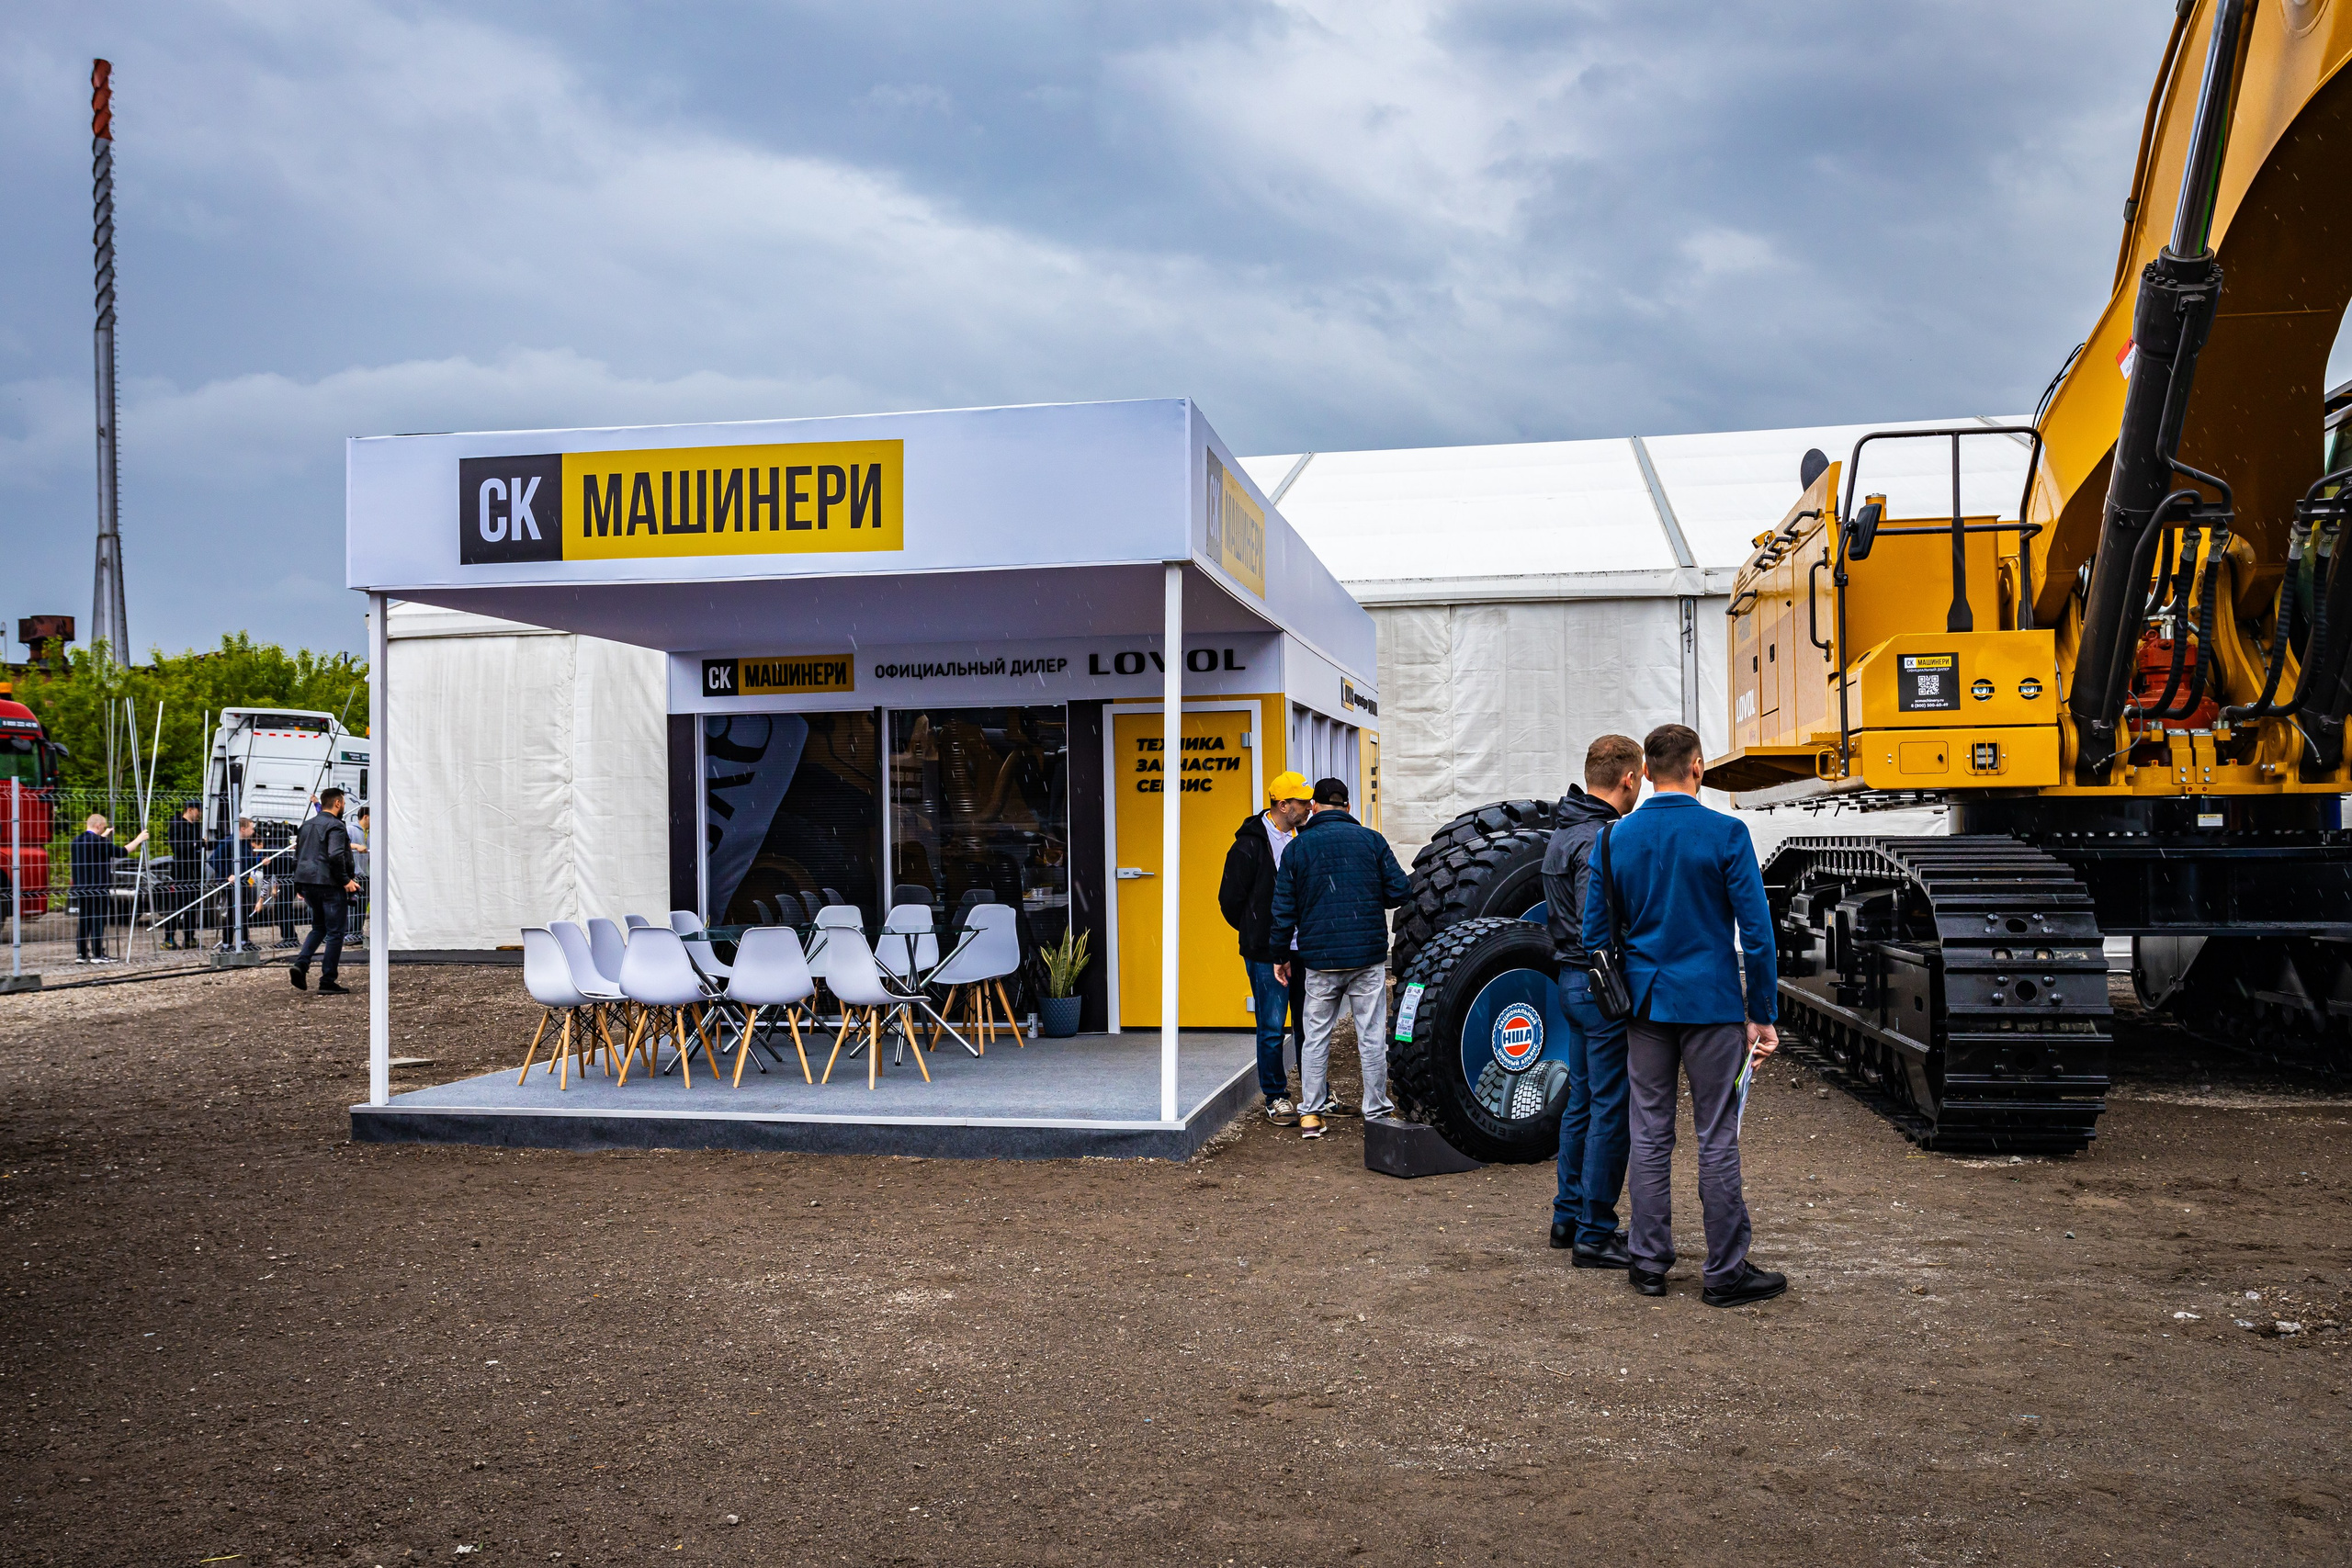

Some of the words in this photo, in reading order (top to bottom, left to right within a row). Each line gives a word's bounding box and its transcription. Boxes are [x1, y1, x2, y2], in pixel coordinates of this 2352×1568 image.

[479, 476, 542, 543] СК
[583, 463, 882, 538] МАШИНЕРИ
[1209, 473, 1220, 543] СК
[1225, 489, 1263, 581] МАШИНЕРИ
[708, 665, 732, 690] СК
[744, 661, 847, 688] МАШИНЕРИ
[875, 658, 1006, 680] ОФИЦИАЛЬНЫЙ
[1010, 658, 1068, 677] ДИЛЕР
[1736, 689, 1756, 723] LOVOL
[1498, 1008, 1538, 1030] НАЦИОНАЛЬНЫЙ
[1503, 1029, 1532, 1044] НША
[1498, 1047, 1520, 1066] ШИННЫЙ
[1521, 1043, 1539, 1066] АЛЬЯНС
